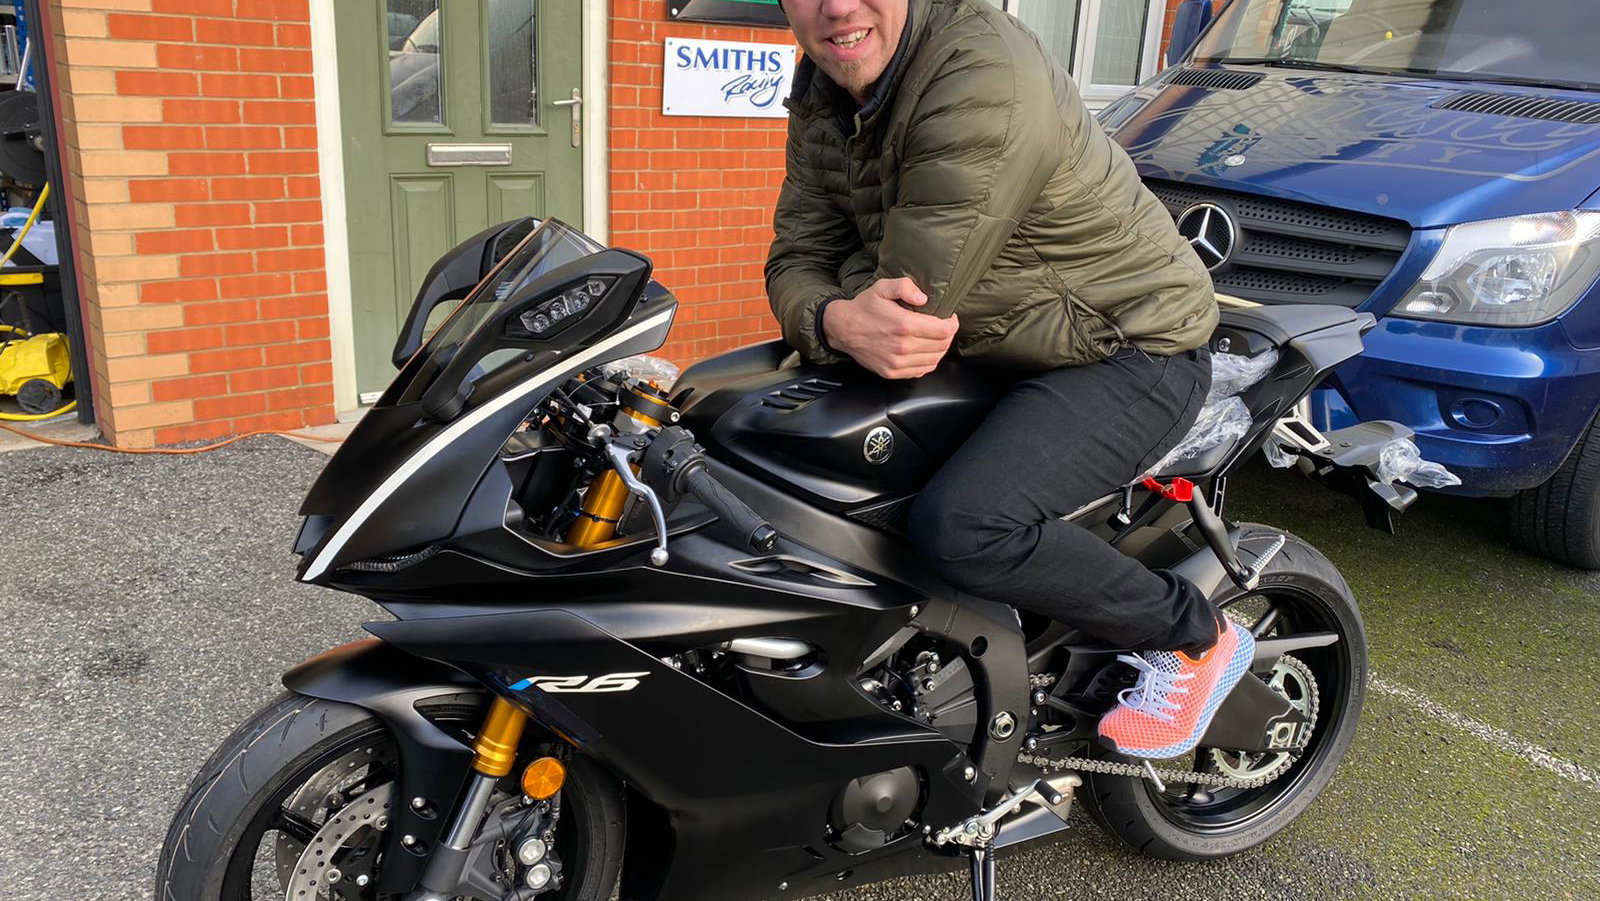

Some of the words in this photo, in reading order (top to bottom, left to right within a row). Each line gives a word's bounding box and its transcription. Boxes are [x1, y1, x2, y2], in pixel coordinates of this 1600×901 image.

[677, 45, 782, 72] SMITHS
[720, 73, 783, 107] Racing
[508, 671, 651, 692] R6
